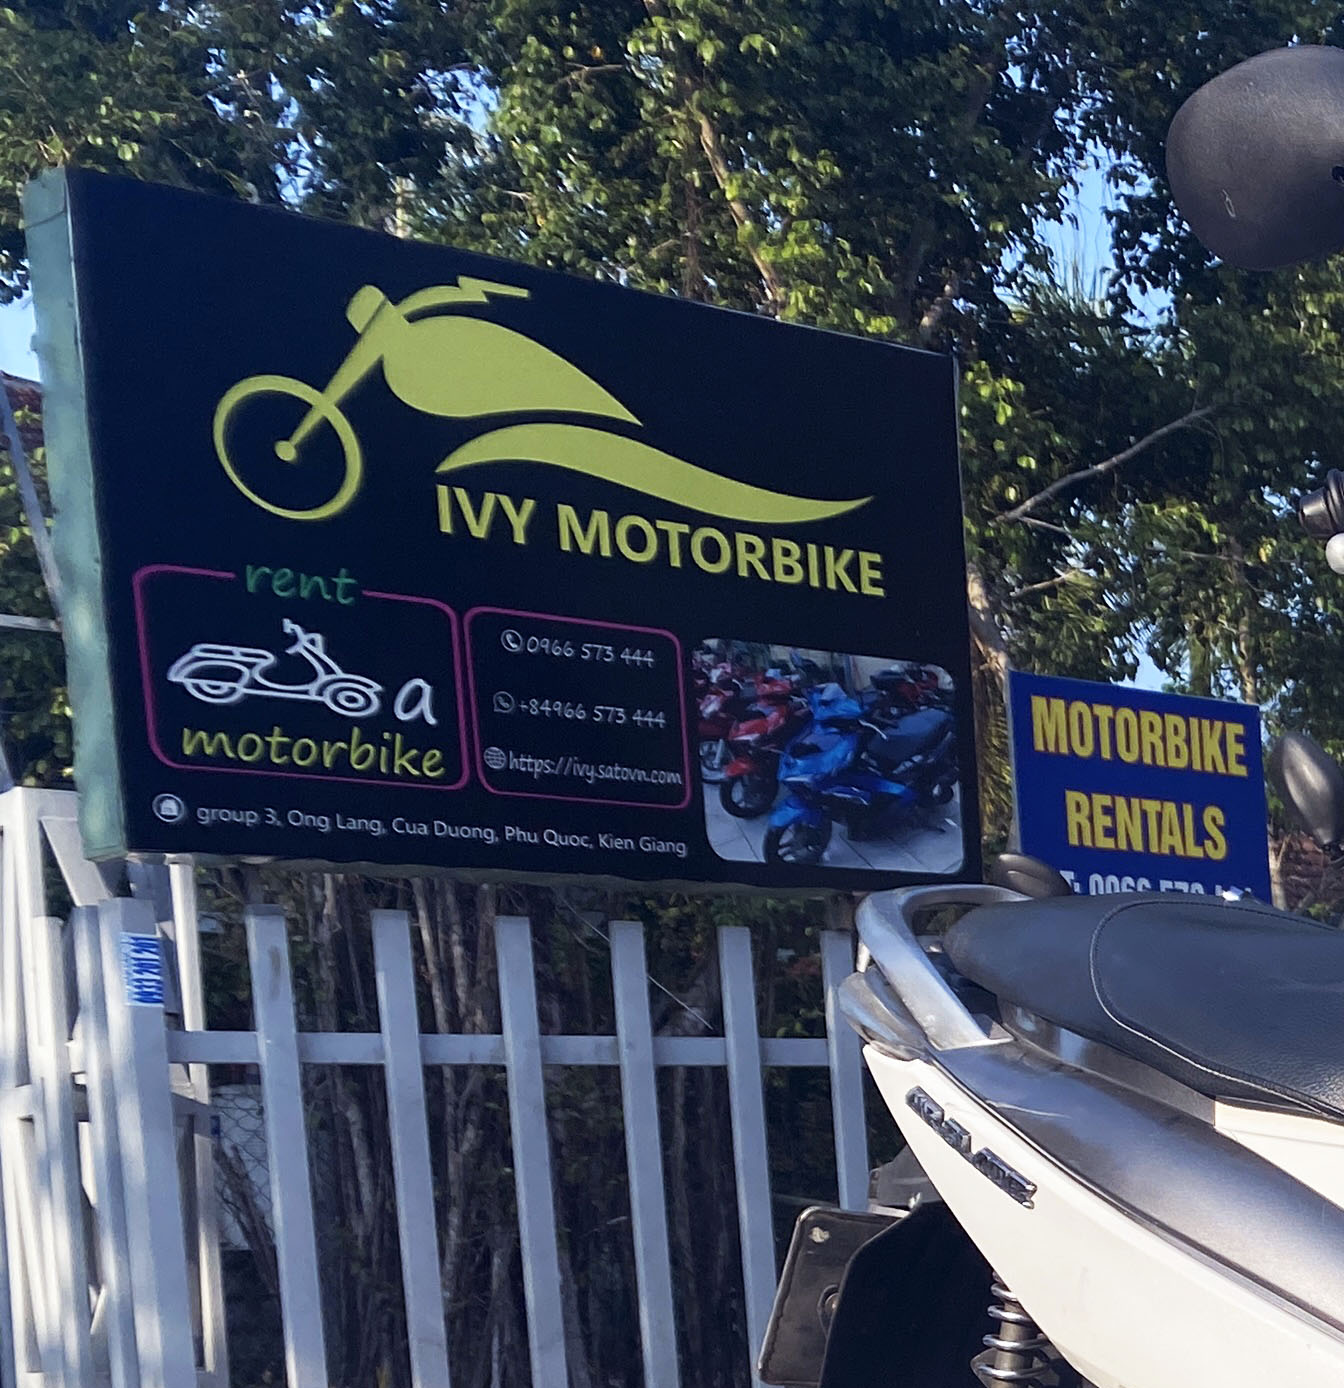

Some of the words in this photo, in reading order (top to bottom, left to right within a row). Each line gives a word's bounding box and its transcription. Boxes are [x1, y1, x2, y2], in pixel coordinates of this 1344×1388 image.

[435, 484, 535, 543] IVY
[557, 504, 885, 597] MOTORBIKE
[246, 564, 358, 604] rent
[527, 636, 574, 656] 0966
[581, 644, 615, 662] 573
[620, 648, 654, 667] 444
[394, 678, 437, 725] a
[519, 698, 586, 719] +84966
[593, 706, 626, 723] 573
[632, 709, 666, 728] 444
[182, 726, 445, 777] motorbike
[1031, 695, 1248, 777] MOTORBIKE
[509, 751, 682, 784] https://ivy.satovn.com
[196, 806, 258, 826] group
[287, 809, 330, 832] Ong
[336, 813, 386, 836] Lang,
[392, 817, 428, 836] Cua
[433, 820, 499, 844] Duong,
[504, 825, 538, 843] Phu
[543, 829, 593, 848] Quoc,
[598, 833, 635, 850] Kien
[639, 836, 688, 858] Giang
[1065, 789, 1228, 861] RENTALS
